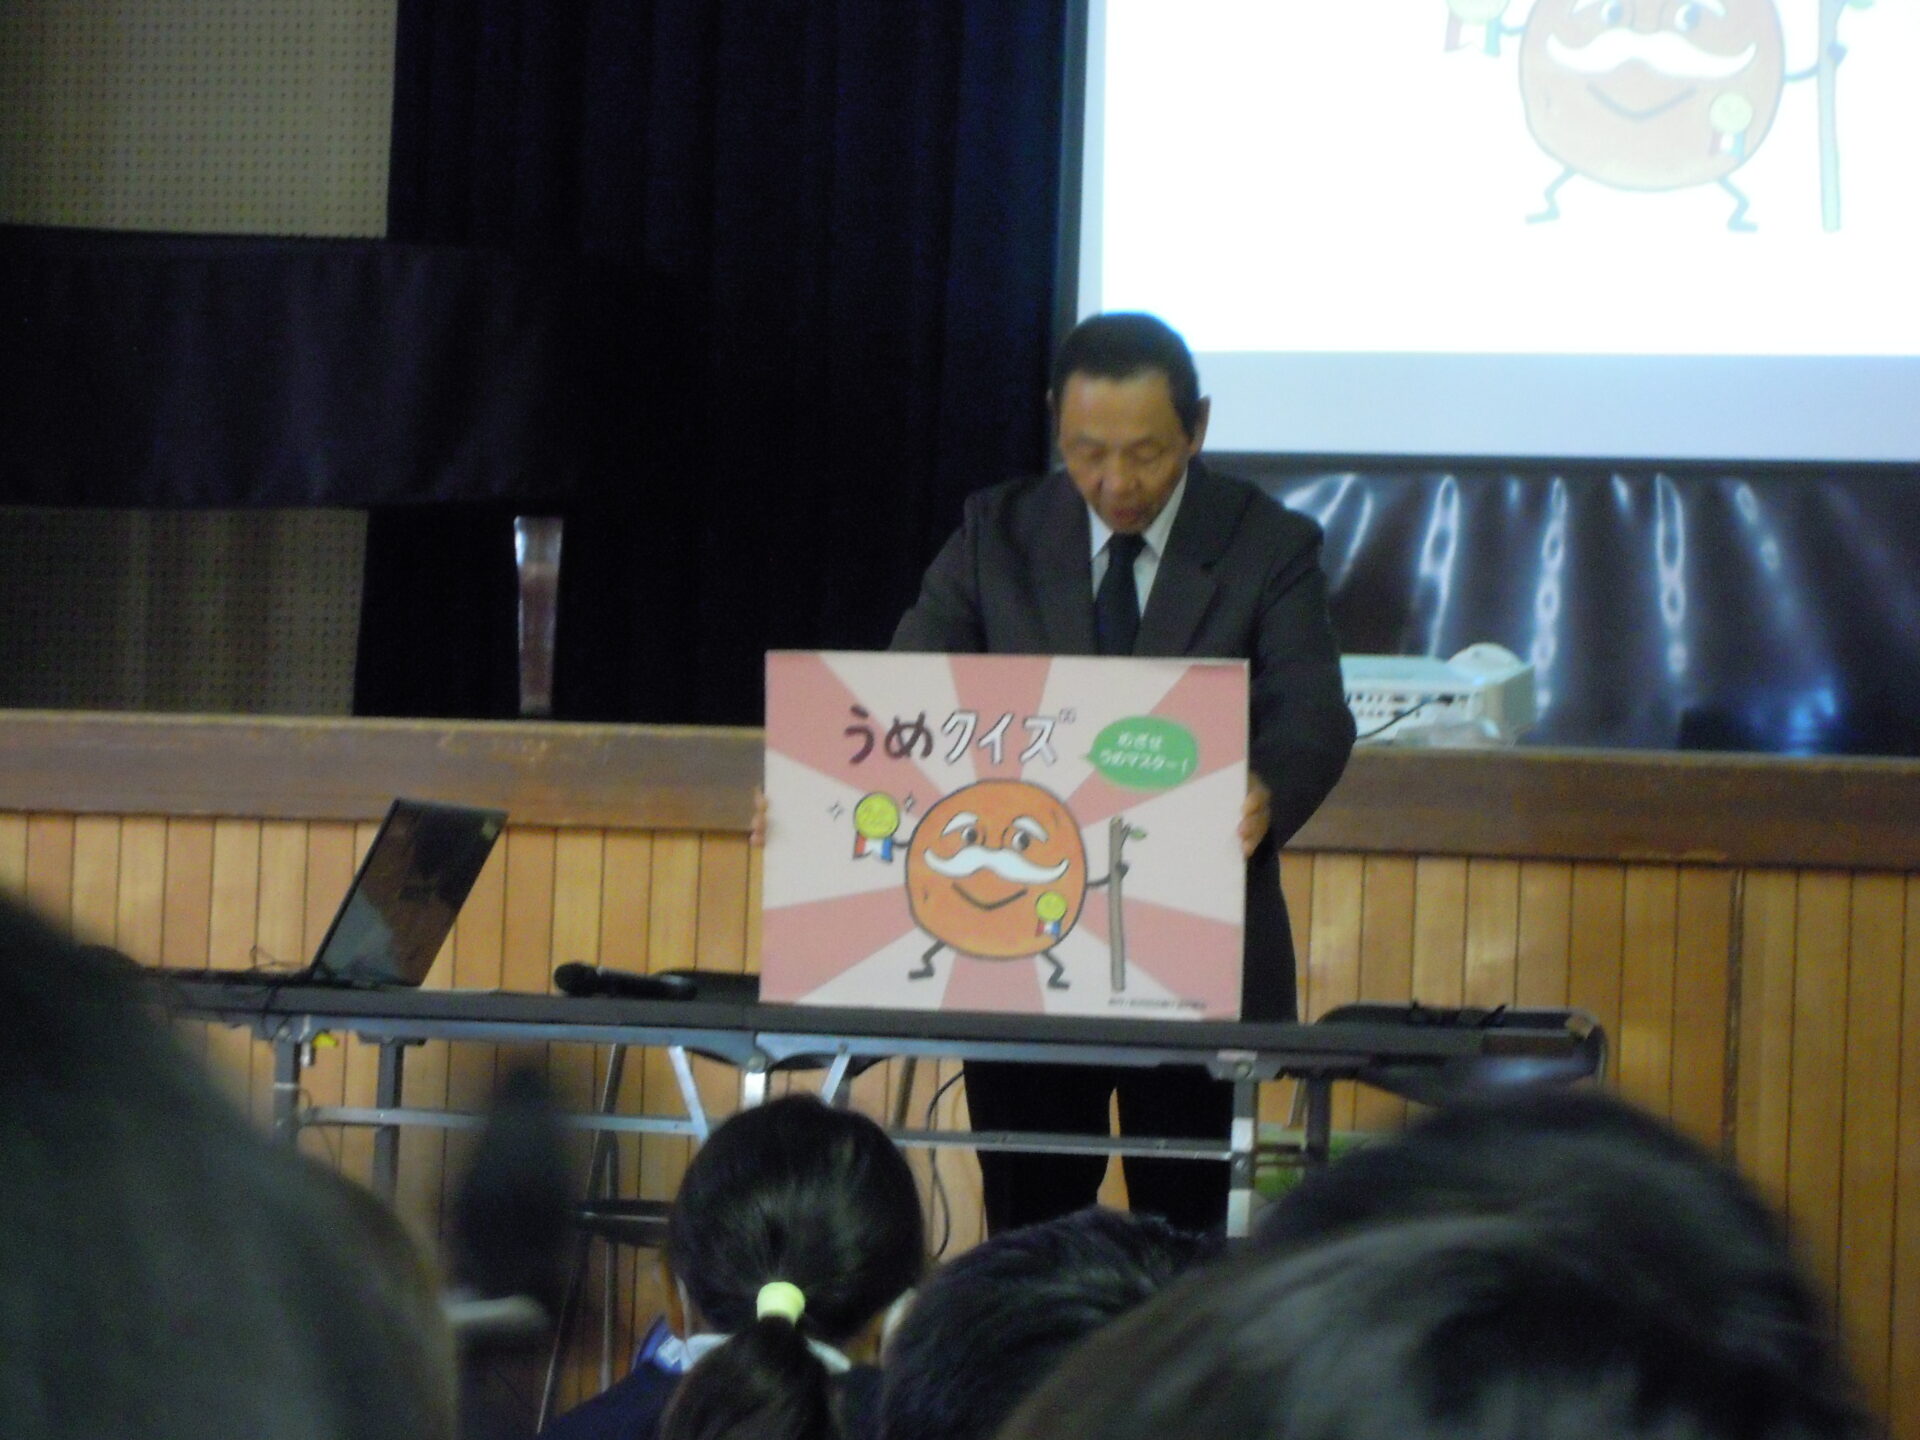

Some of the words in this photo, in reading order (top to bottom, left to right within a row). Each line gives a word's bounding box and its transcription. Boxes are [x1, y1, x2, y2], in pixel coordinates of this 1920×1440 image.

[844, 704, 1077, 765] うめクイズ
